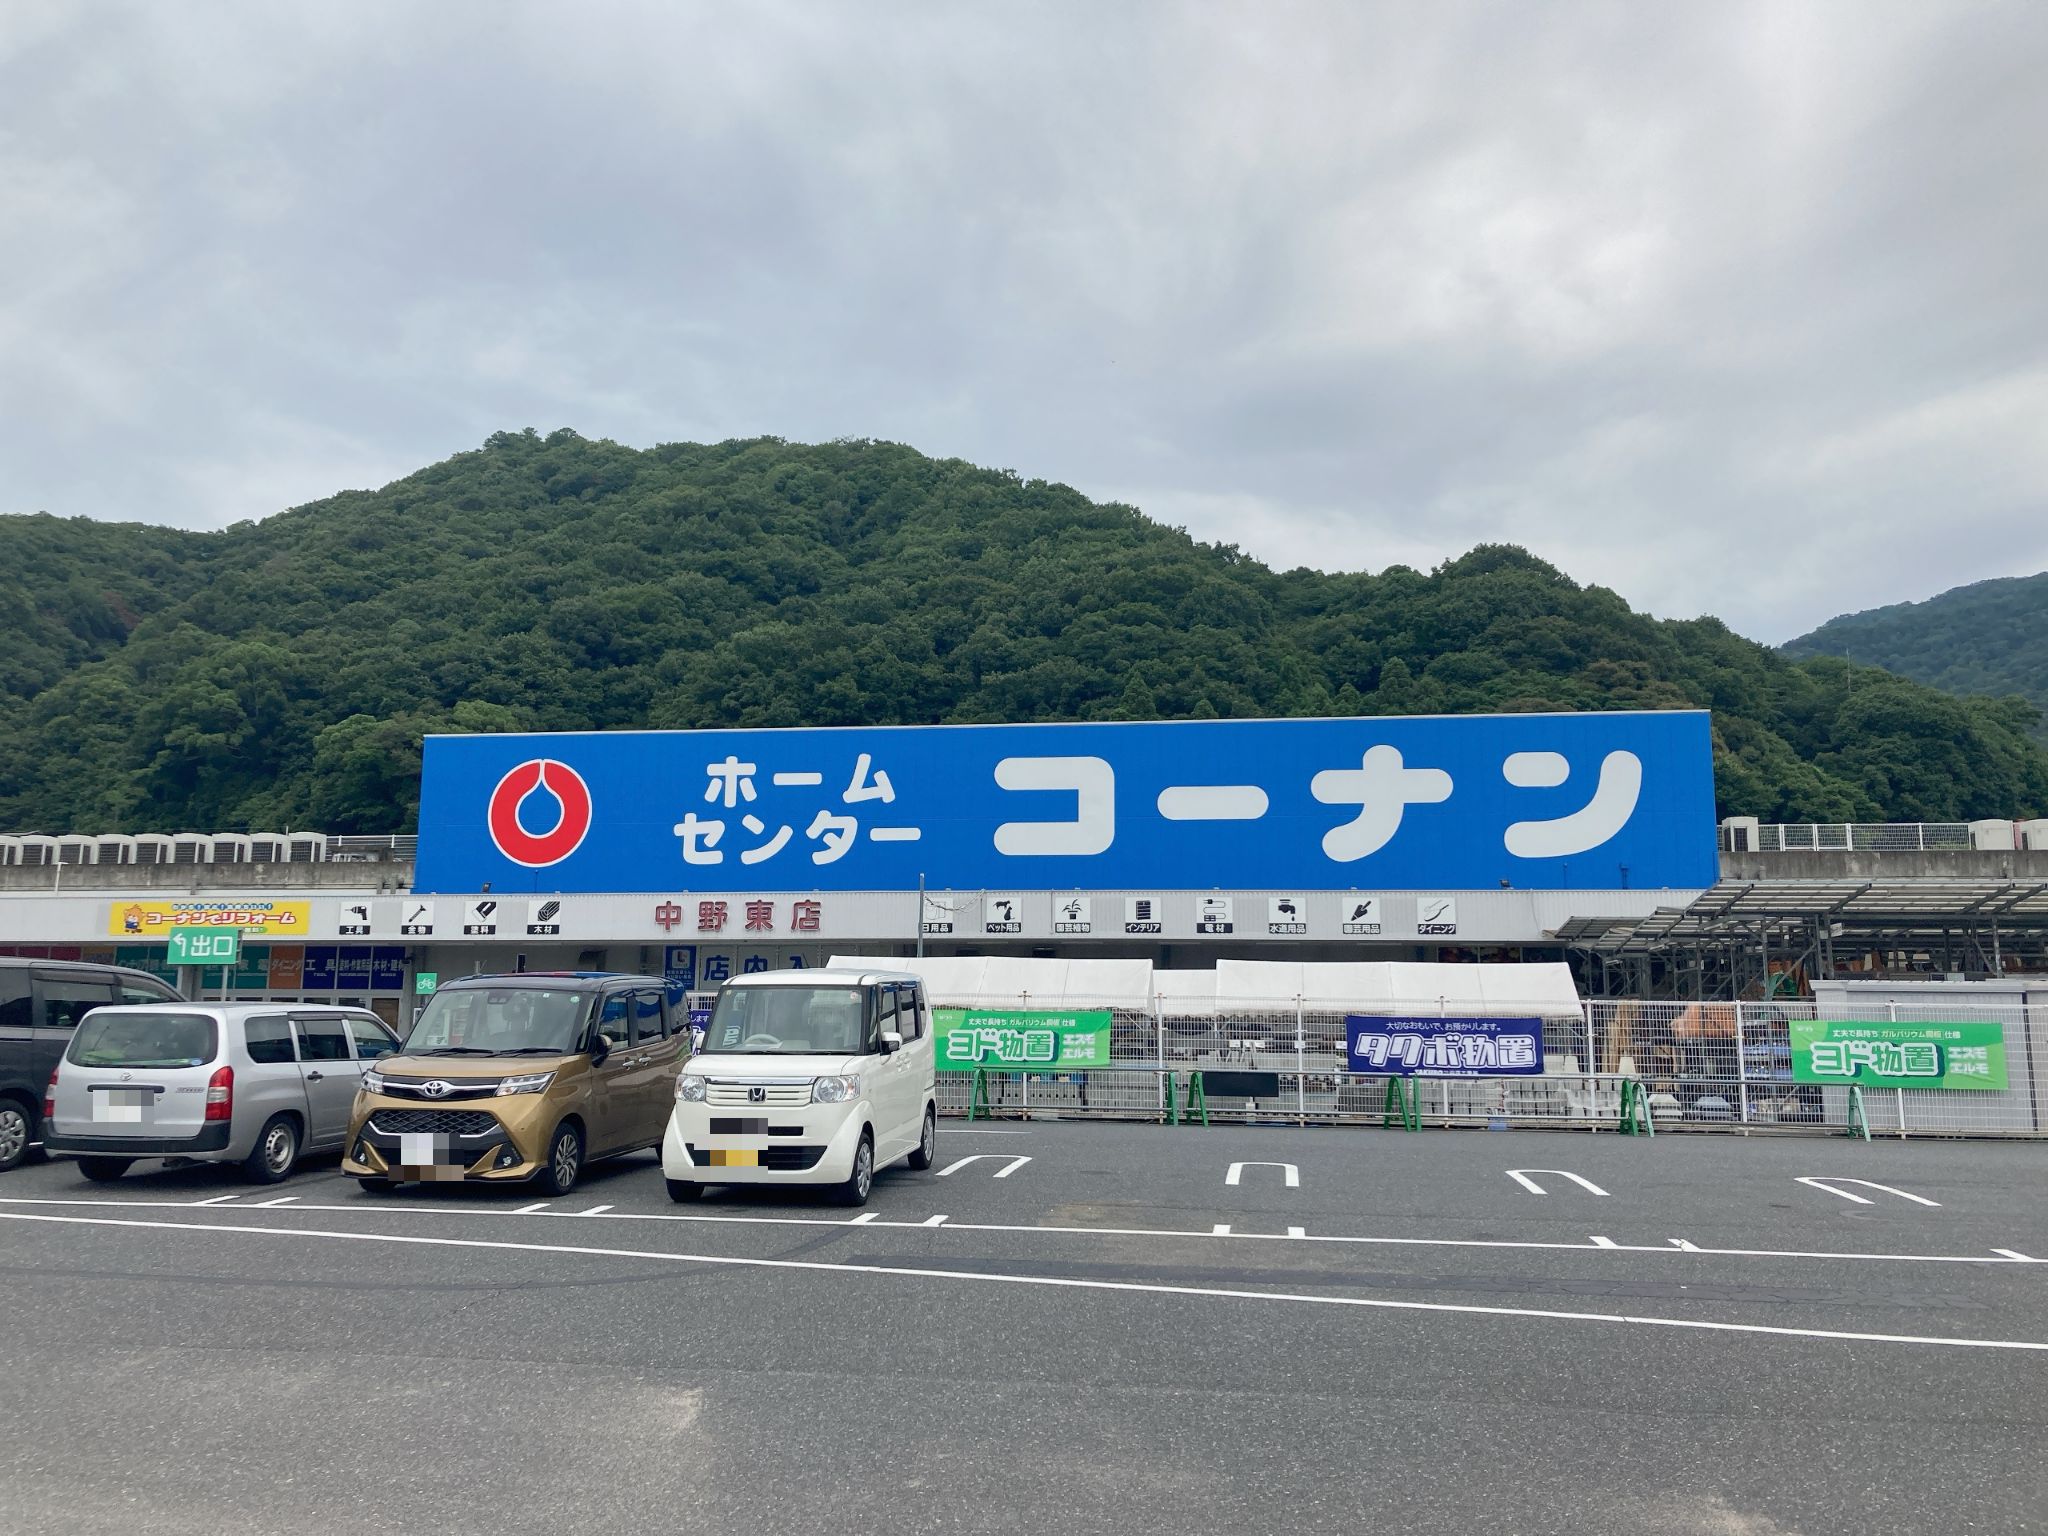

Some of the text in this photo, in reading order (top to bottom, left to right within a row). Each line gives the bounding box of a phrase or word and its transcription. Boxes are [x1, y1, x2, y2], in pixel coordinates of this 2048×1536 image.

[704, 753, 896, 808] ホーム
[993, 744, 1643, 863] コーナン
[673, 809, 922, 865] センター
[655, 899, 822, 932] 中野東店
[345, 925, 364, 934] 工具
[407, 925, 427, 934] 金物
[470, 925, 490, 934] 塗料
[533, 925, 553, 934] 木材
[922, 923, 949, 933] 日用品
[987, 923, 1020, 932] ペット用品
[1126, 923, 1161, 932] インテリア
[1204, 923, 1225, 933] 電材
[1269, 923, 1306, 933] 水道用品
[1418, 924, 1456, 934] ダイニング
[190, 933, 234, 957] 出口
[947, 1028, 1058, 1062] ヨド物置
[1355, 1032, 1537, 1068] タクボ物置
[1809, 1040, 1941, 1077] ヨド物置
